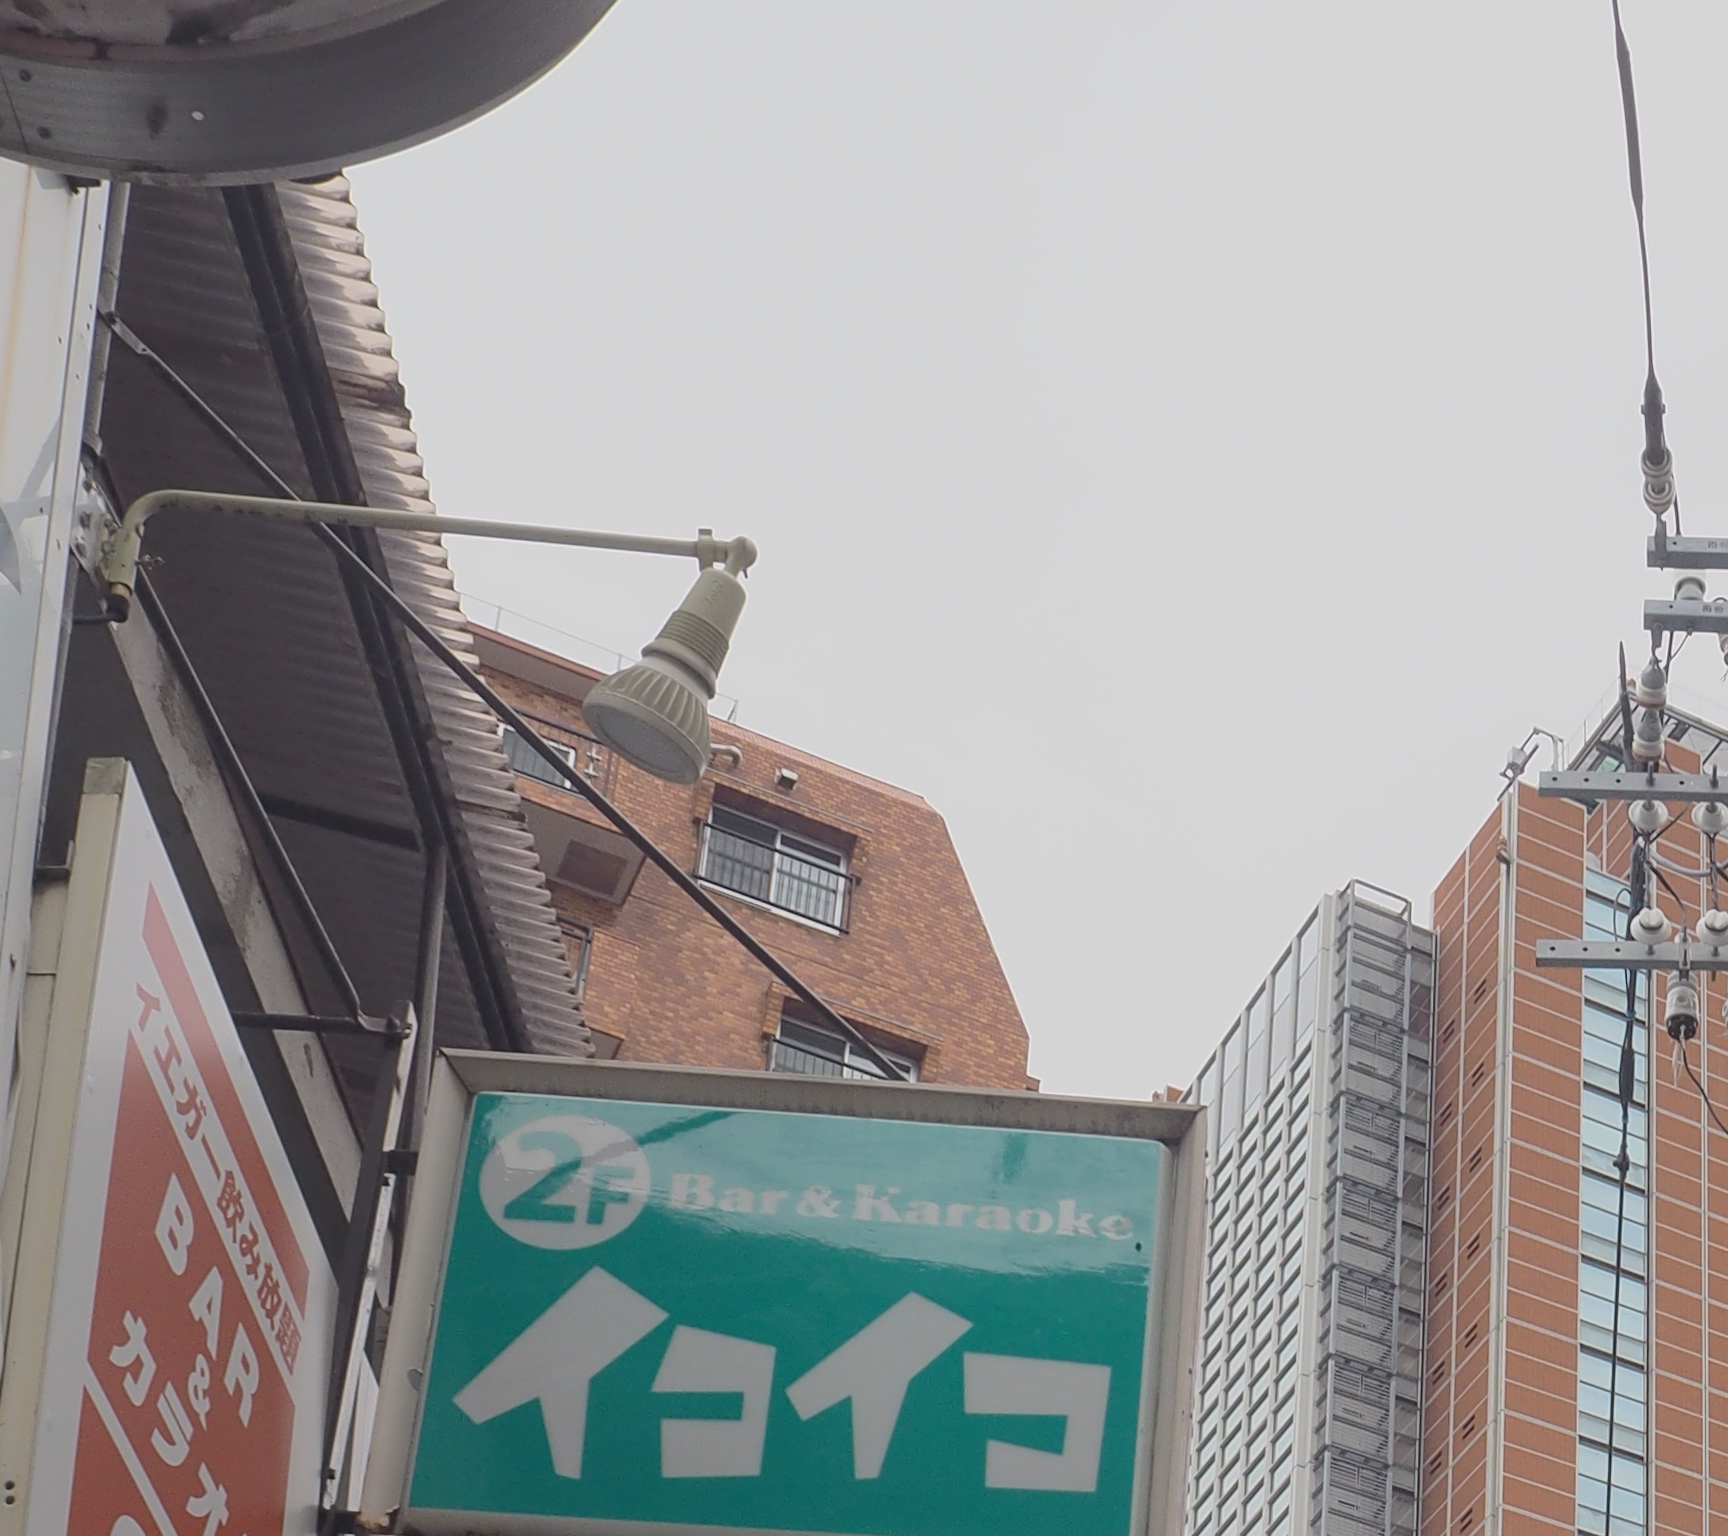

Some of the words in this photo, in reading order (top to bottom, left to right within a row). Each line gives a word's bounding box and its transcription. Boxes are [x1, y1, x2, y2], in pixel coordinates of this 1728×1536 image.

[502, 1129, 636, 1227] 2F
[154, 1172, 260, 1428] BAR
[452, 1264, 1113, 1493] イコイコ
